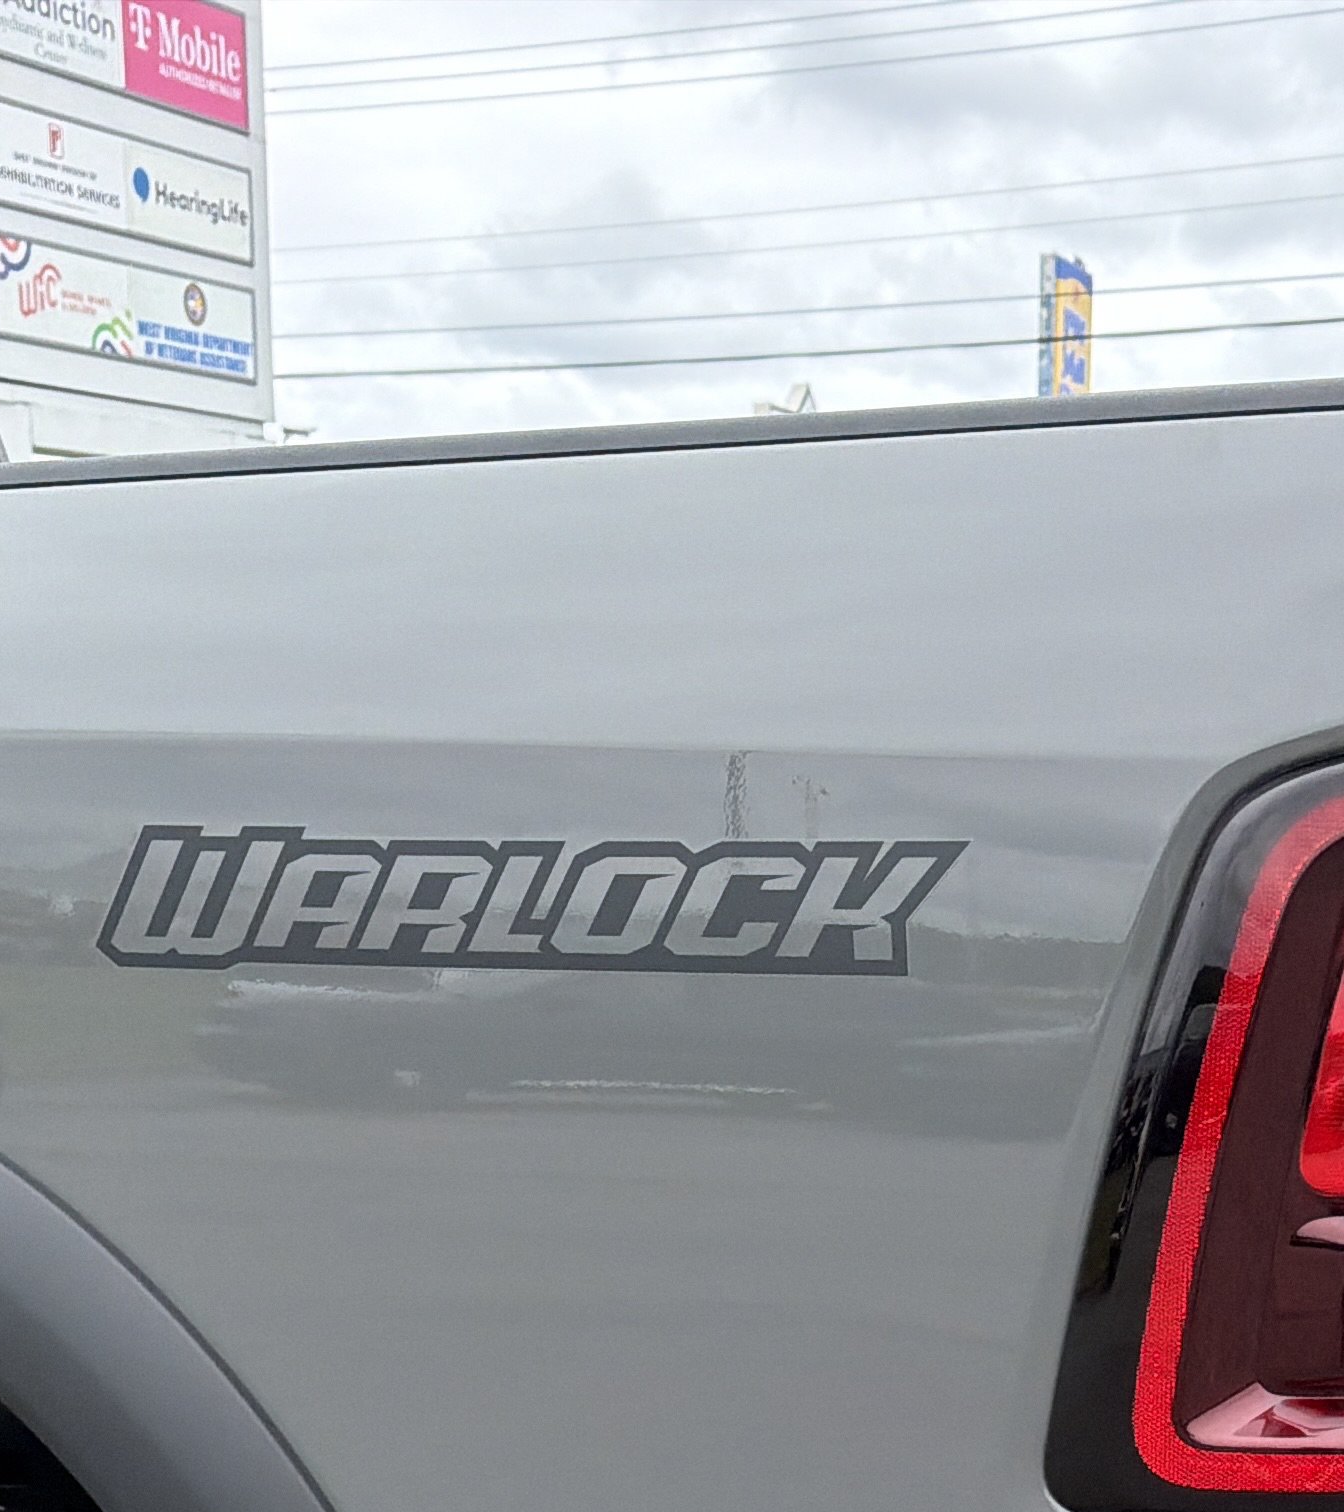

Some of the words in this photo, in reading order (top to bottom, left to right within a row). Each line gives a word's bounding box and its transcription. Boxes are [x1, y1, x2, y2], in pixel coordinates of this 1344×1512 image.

[3, 0, 116, 42] diction
[154, 180, 249, 226] HearingLife
[97, 824, 971, 976] WARLOCK
